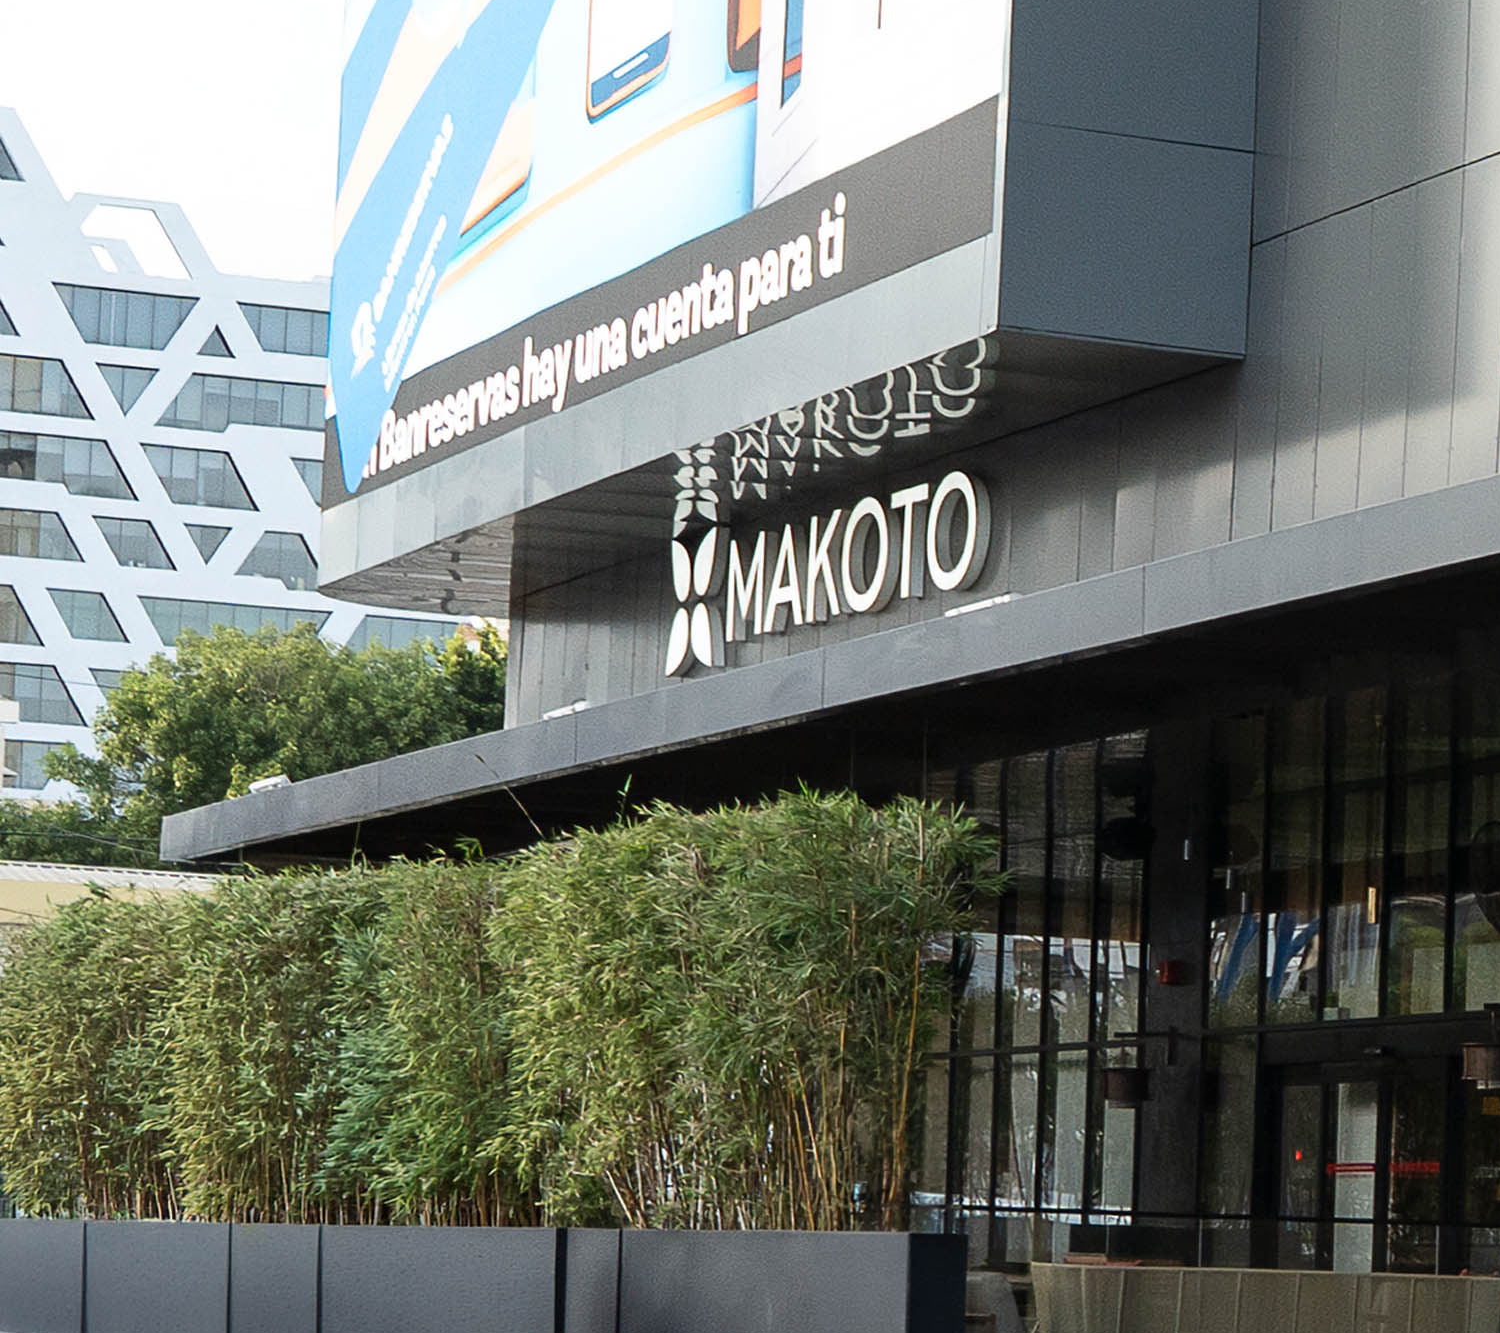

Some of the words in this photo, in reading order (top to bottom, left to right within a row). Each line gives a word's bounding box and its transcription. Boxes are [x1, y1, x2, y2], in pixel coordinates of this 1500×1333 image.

[379, 365, 520, 471] Banreservas
[522, 335, 574, 413] hay
[575, 317, 628, 383] una
[631, 262, 734, 360] cuenta
[738, 235, 812, 334] para
[817, 192, 847, 278] ti
[726, 470, 985, 642] MAKOTO
